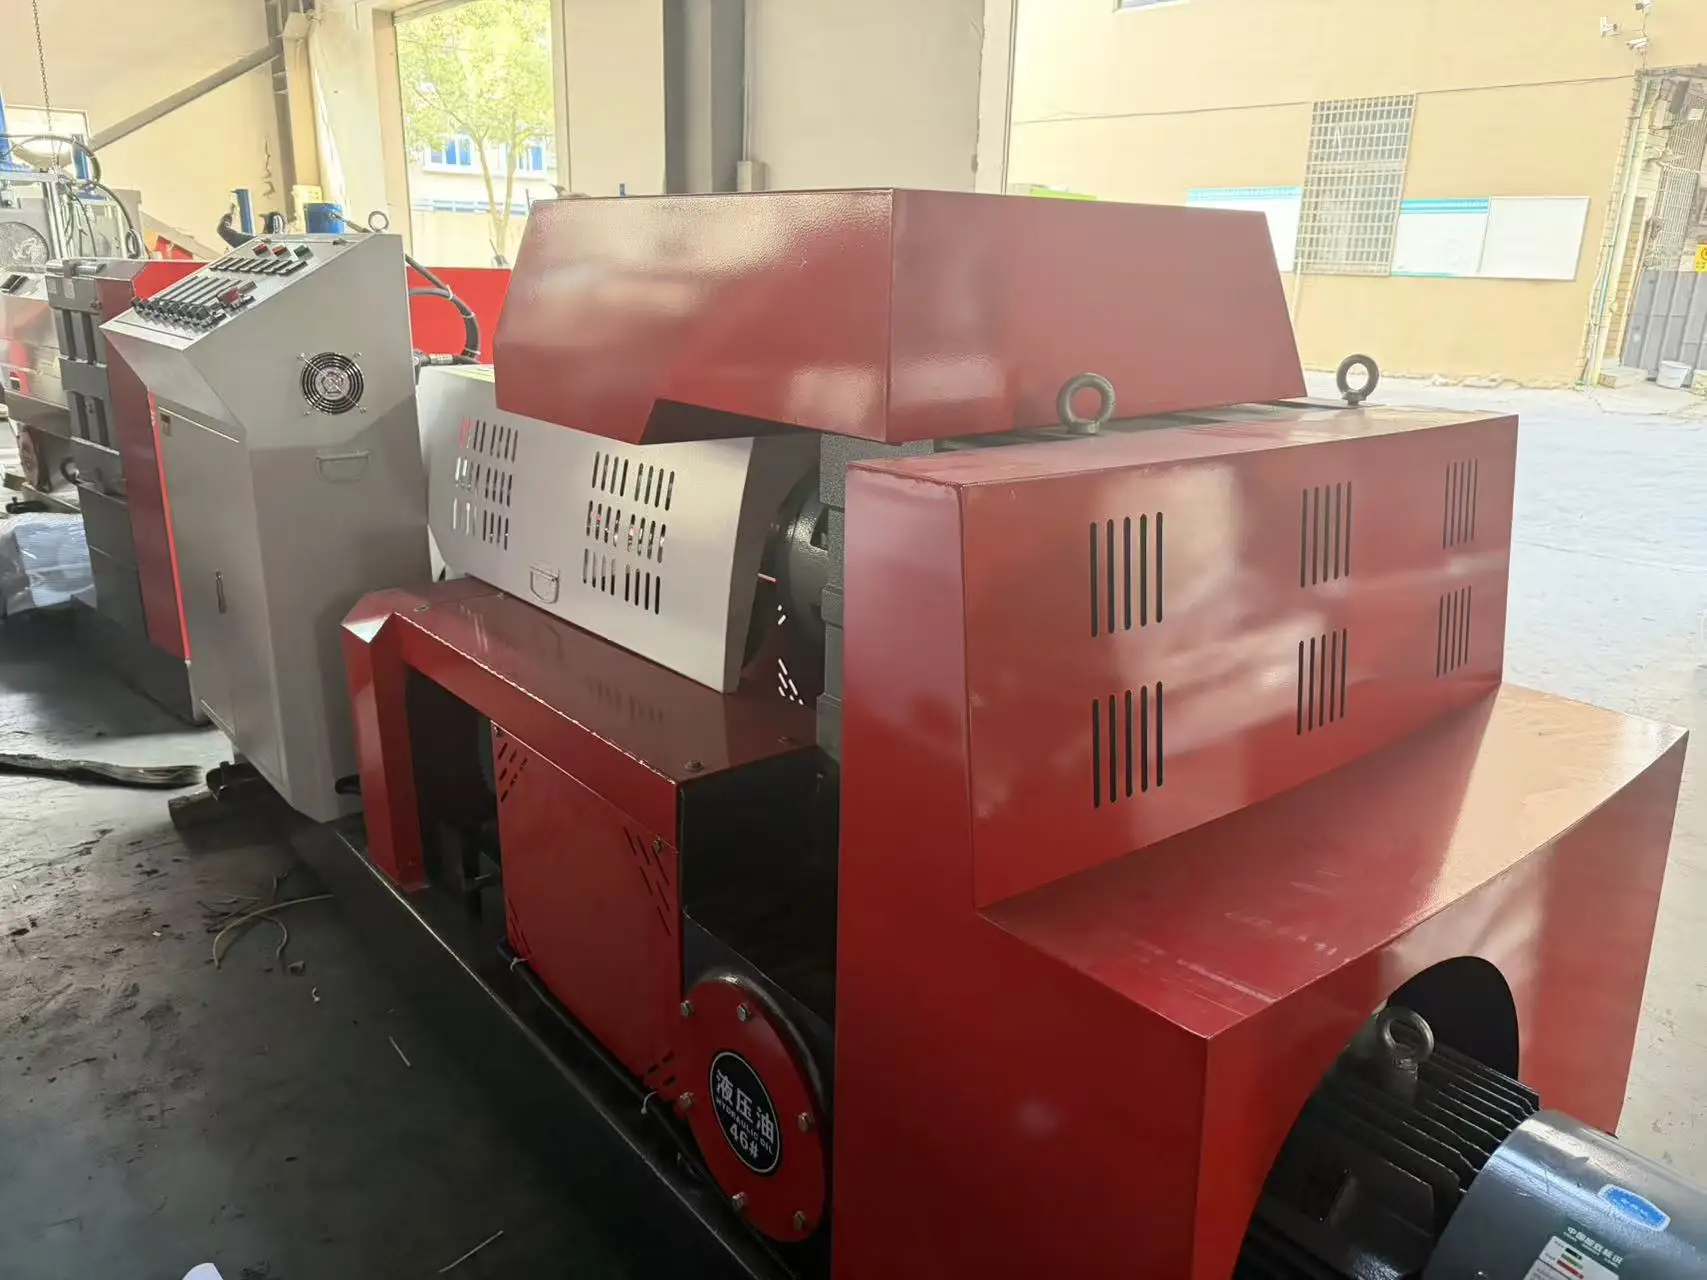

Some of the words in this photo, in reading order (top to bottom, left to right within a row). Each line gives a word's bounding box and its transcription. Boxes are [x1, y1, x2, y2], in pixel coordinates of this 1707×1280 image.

[716, 1069, 774, 1144] 液压油
[716, 1097, 759, 1140] HYDRAULIC
[760, 1138, 773, 1155] OIL
[730, 1123, 759, 1159] 46#
